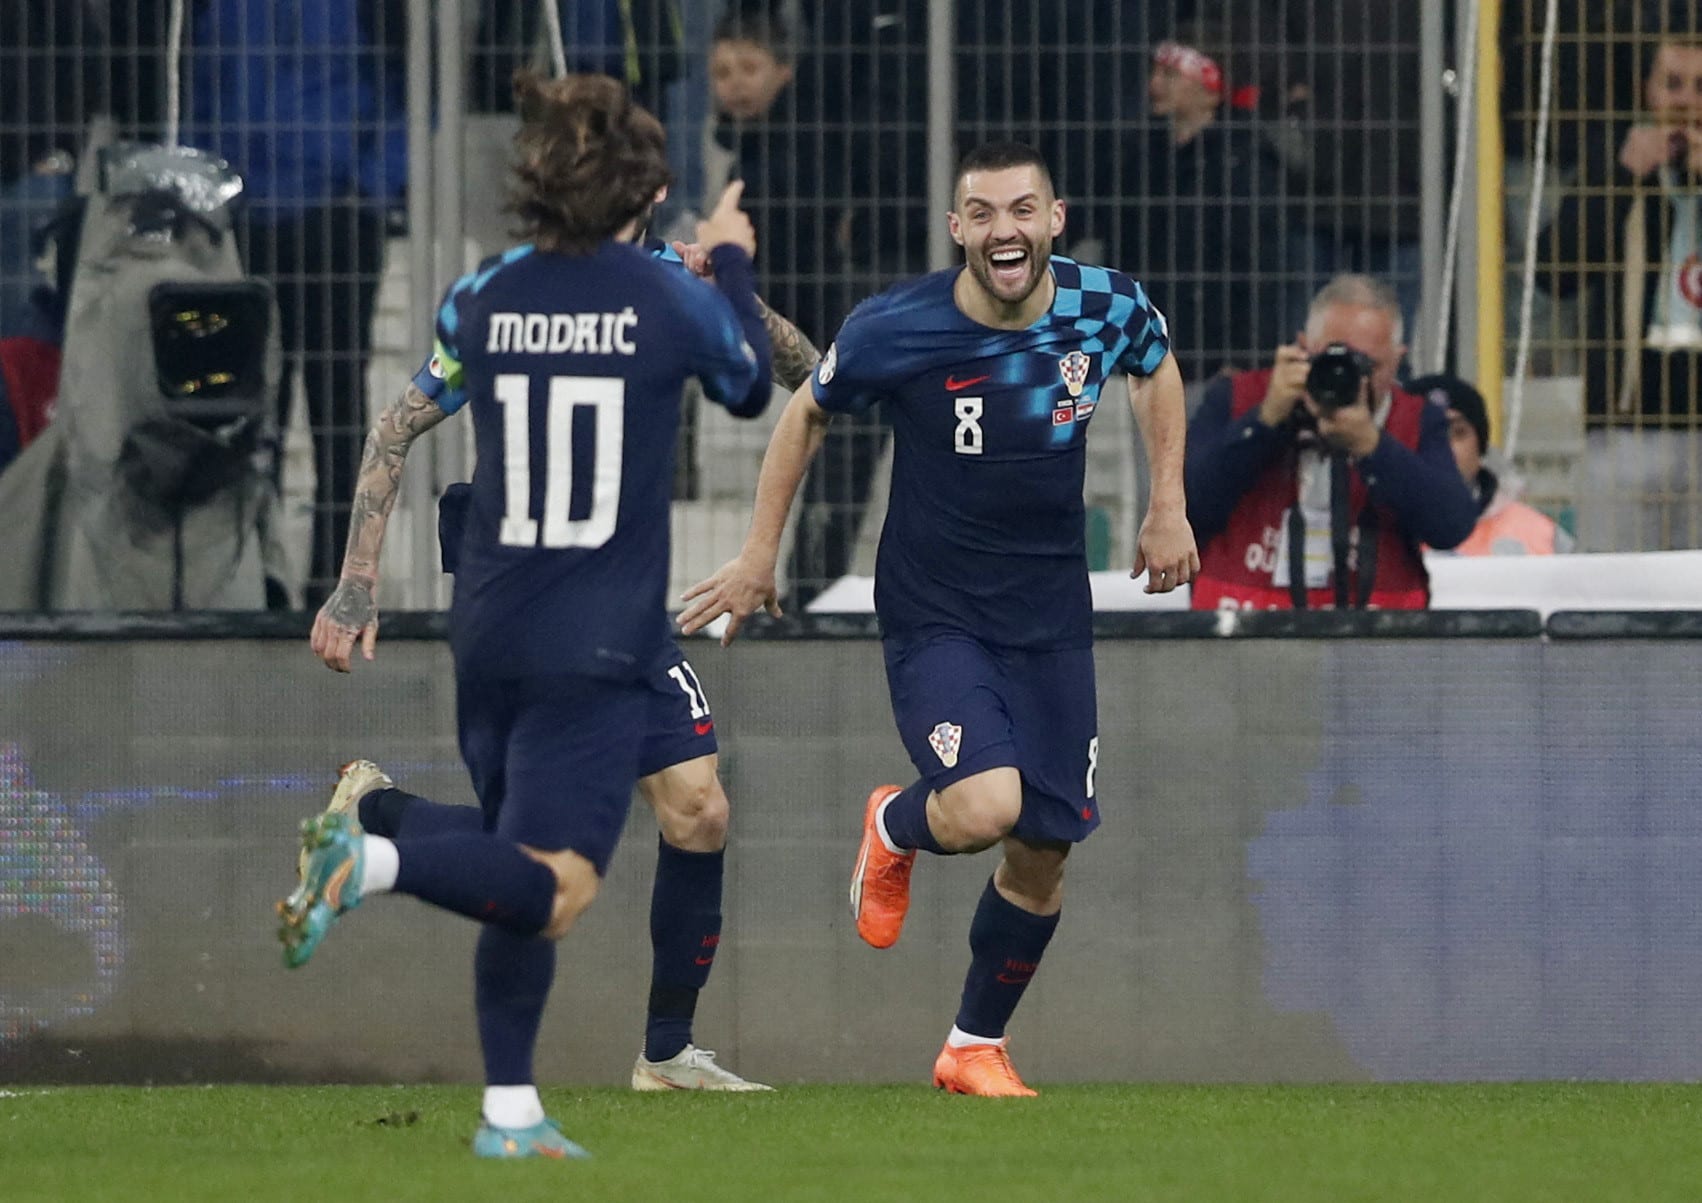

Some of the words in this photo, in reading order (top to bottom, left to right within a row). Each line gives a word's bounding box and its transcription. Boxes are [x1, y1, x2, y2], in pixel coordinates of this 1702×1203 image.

[486, 306, 638, 355] MODRIĆ
[955, 397, 983, 454] 8
[494, 374, 626, 549] 10
[667, 660, 710, 719] 11
